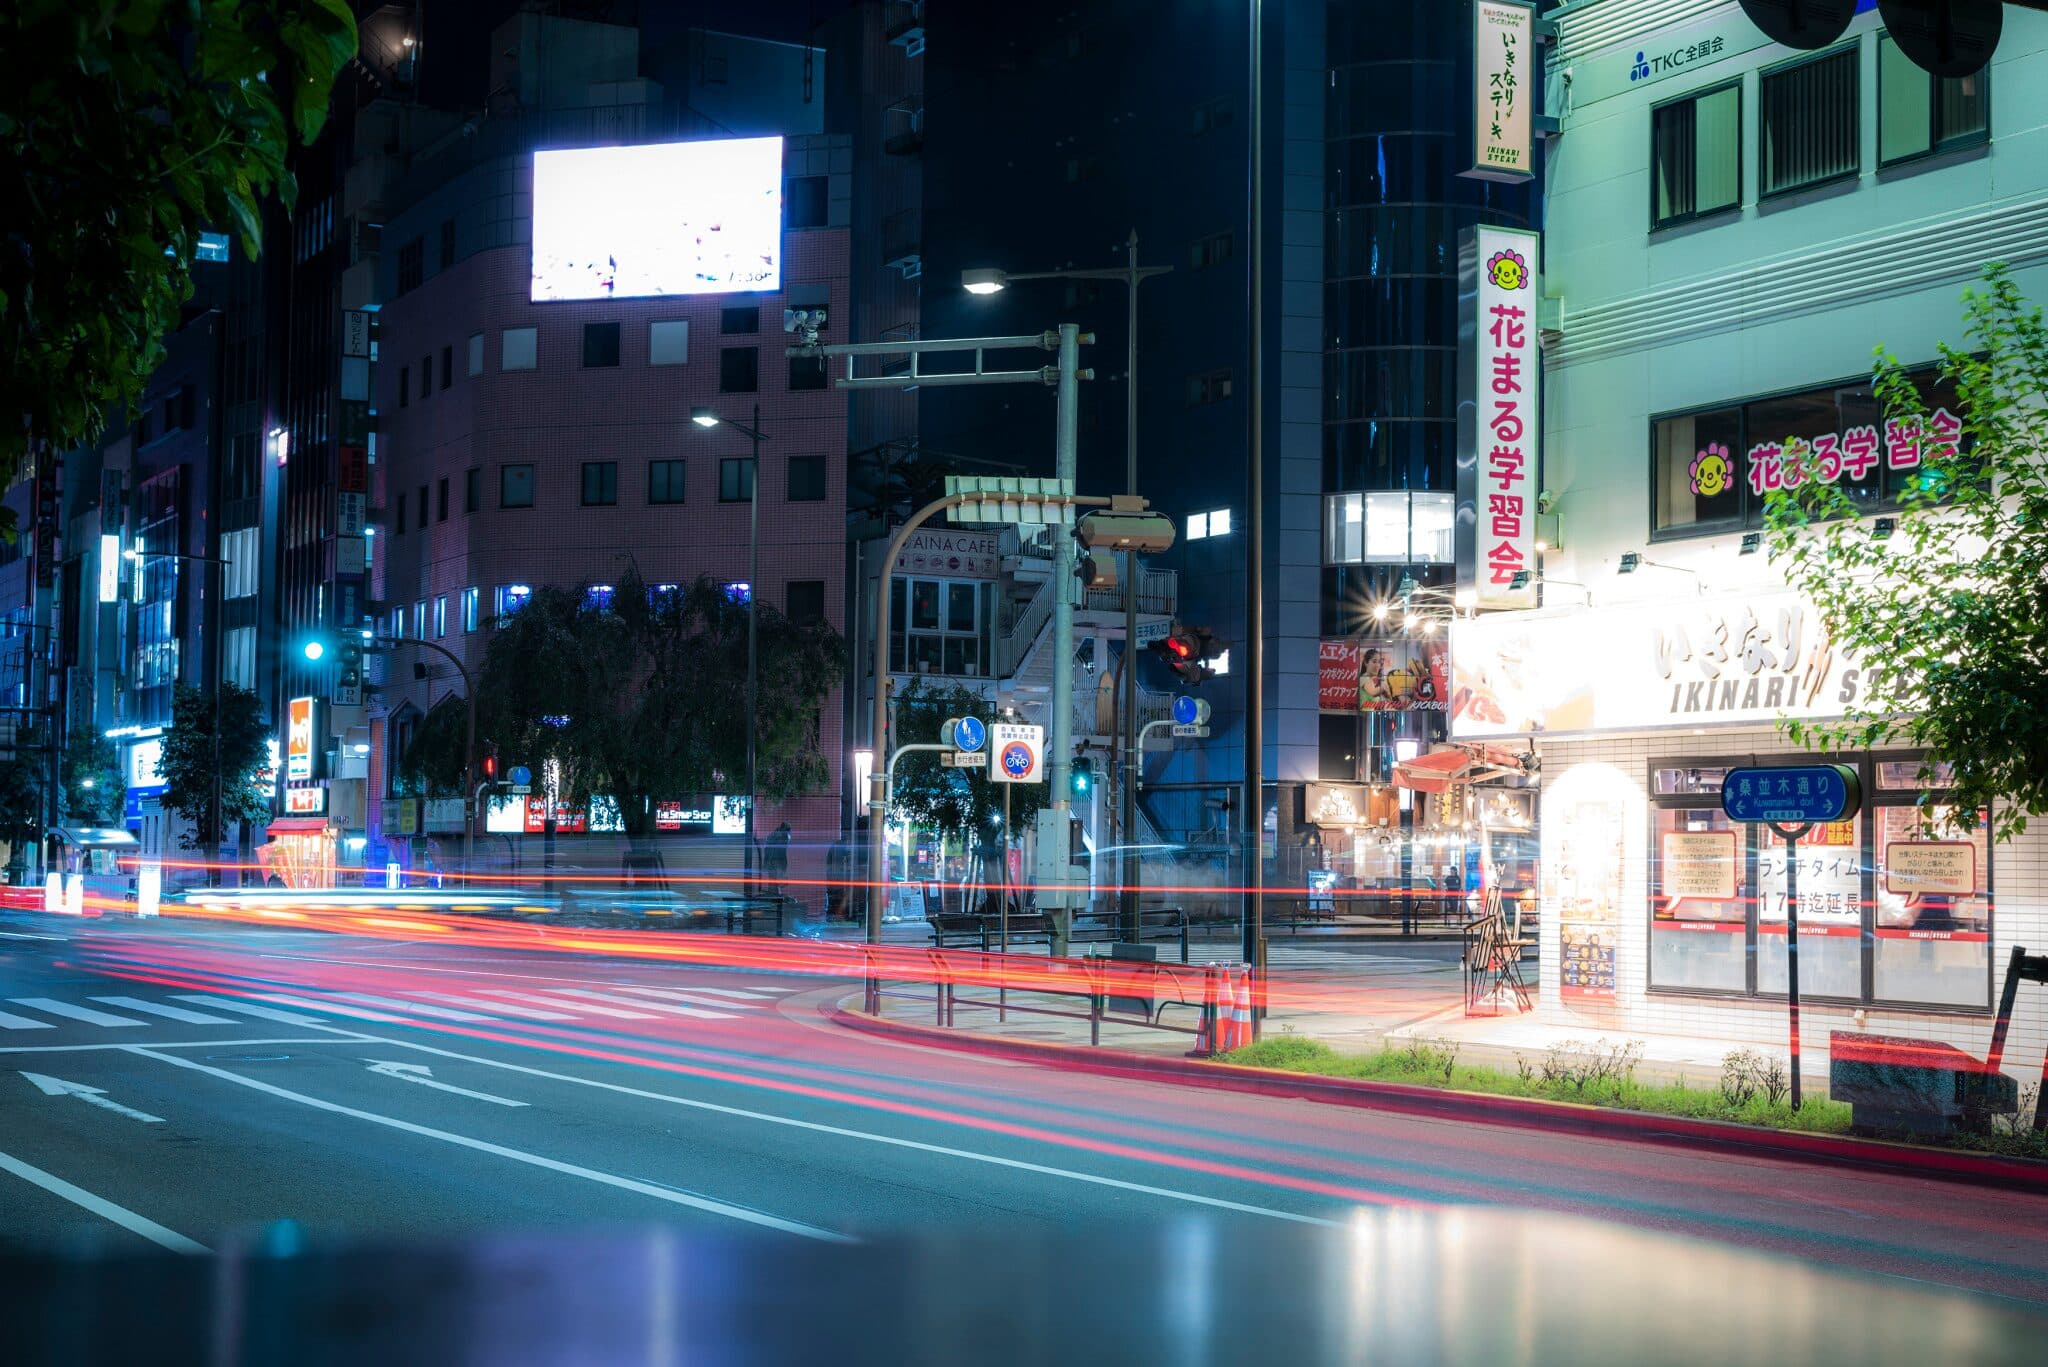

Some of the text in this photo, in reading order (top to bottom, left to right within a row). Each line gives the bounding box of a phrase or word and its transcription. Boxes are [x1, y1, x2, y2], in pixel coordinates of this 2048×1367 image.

[1502, 32, 1517, 106] いきなり
[1651, 36, 1724, 73] TKC全国会
[1490, 73, 1504, 140] ステーキ
[1487, 146, 1520, 157] IKINARI
[1488, 154, 1517, 164] STEAK
[1488, 303, 1526, 584] 花まる学習会
[956, 538, 995, 555] CAFE
[1670, 675, 1800, 713] IKINARI
[1740, 776, 1829, 796] 桑並木通り
[1760, 857, 1860, 878] ランチタイム
